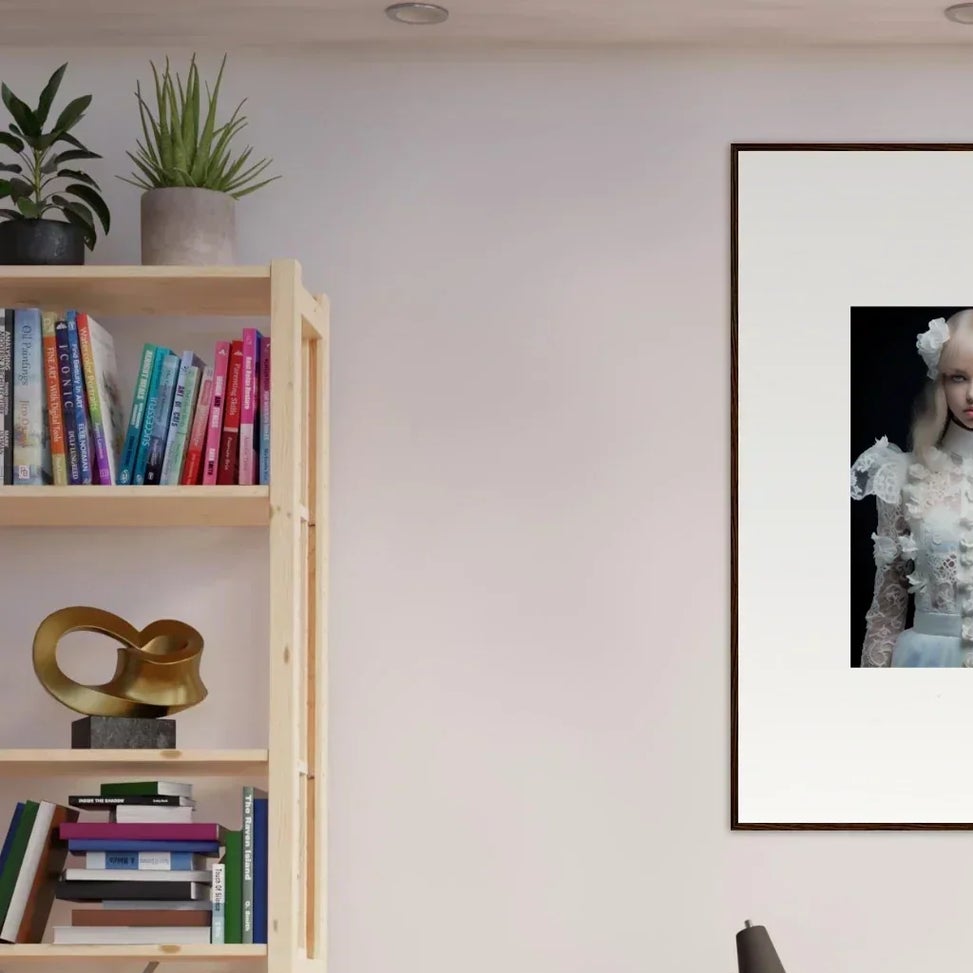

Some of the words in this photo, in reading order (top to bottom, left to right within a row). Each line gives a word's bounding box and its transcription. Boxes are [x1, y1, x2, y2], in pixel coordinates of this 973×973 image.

[22, 325, 32, 340] Oil
[18, 342, 32, 386] Paintings
[59, 345, 73, 409] ICONIC
[80, 326, 92, 373] Watercolor
[86, 374, 98, 410] Portraits
[231, 363, 240, 396] Parenting
[50, 402, 60, 425] Digital
[229, 398, 238, 416] Skills
